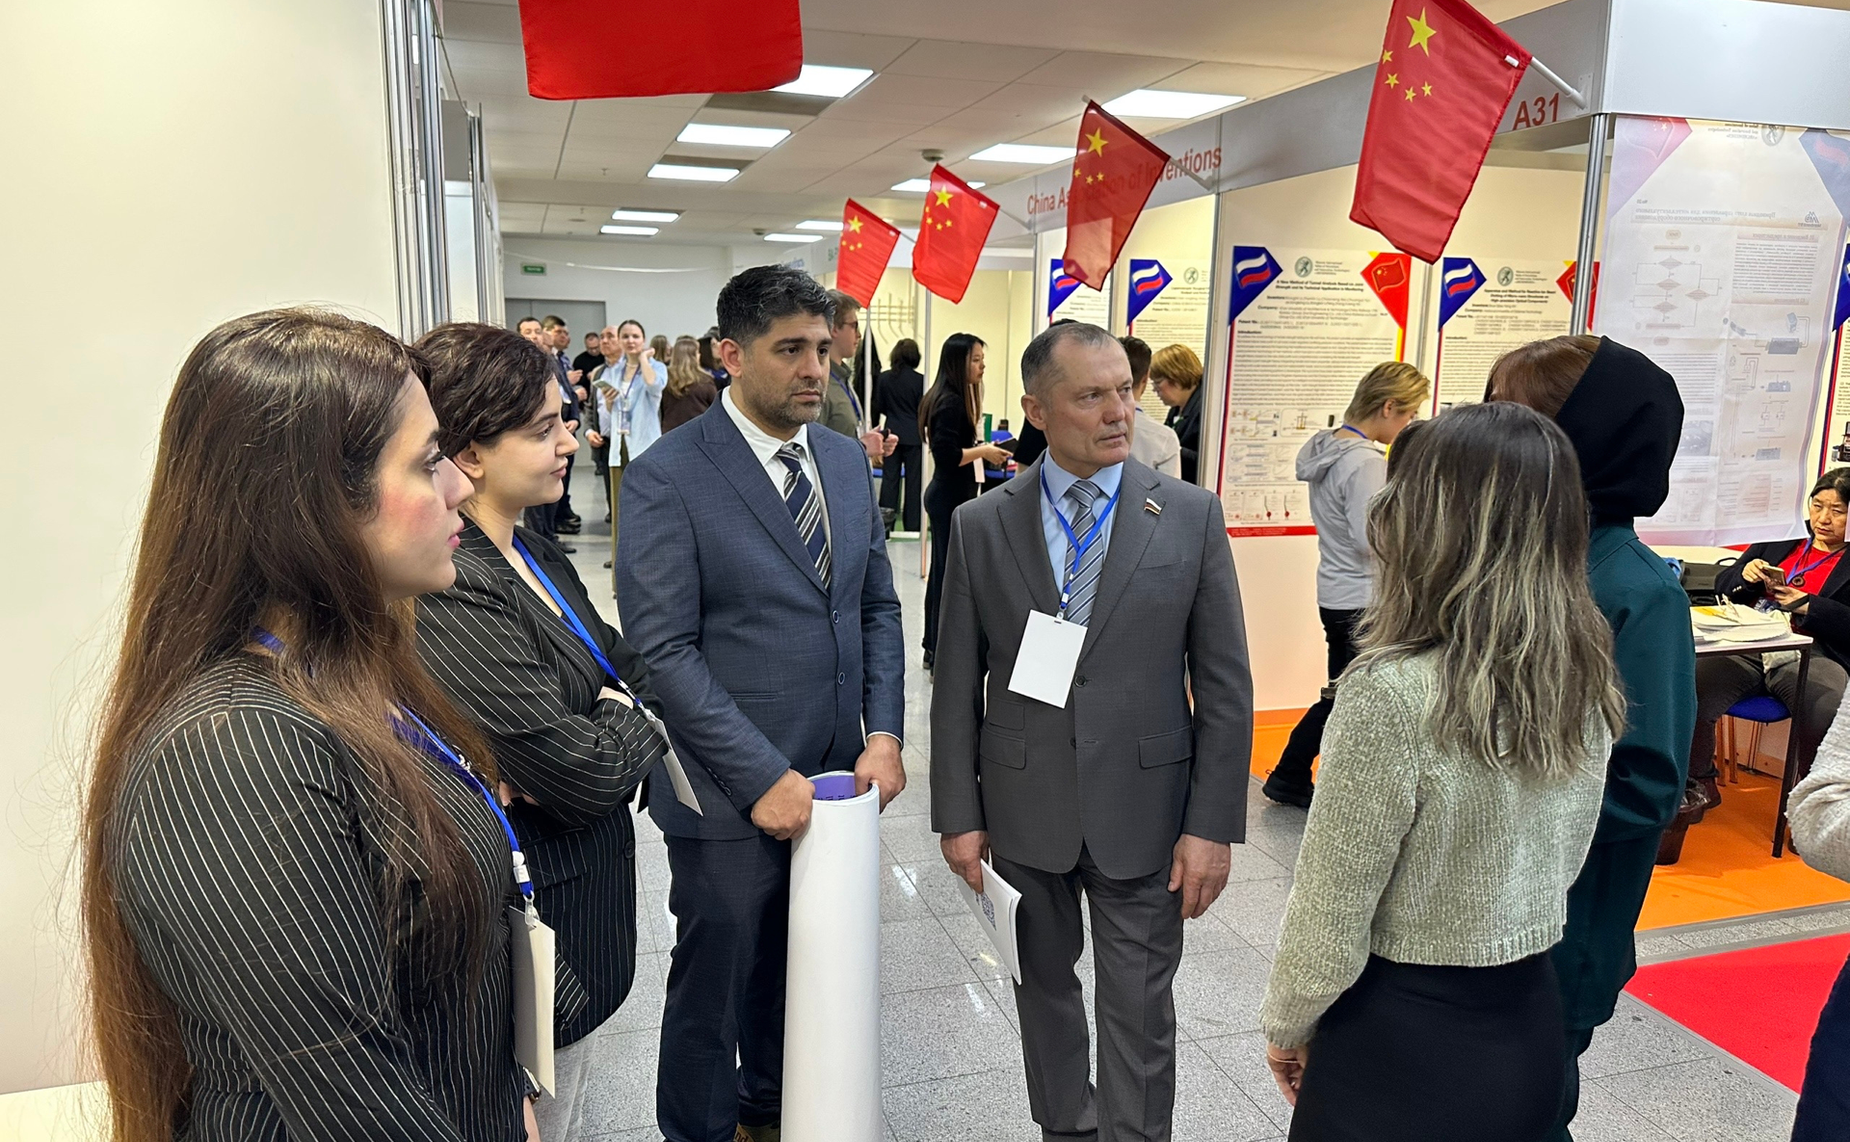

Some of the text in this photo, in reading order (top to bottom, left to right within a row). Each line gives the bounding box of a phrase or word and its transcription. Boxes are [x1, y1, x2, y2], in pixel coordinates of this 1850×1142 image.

[1513, 93, 1559, 131] A31
[1027, 189, 1055, 215] China
[1128, 162, 1142, 190] of
